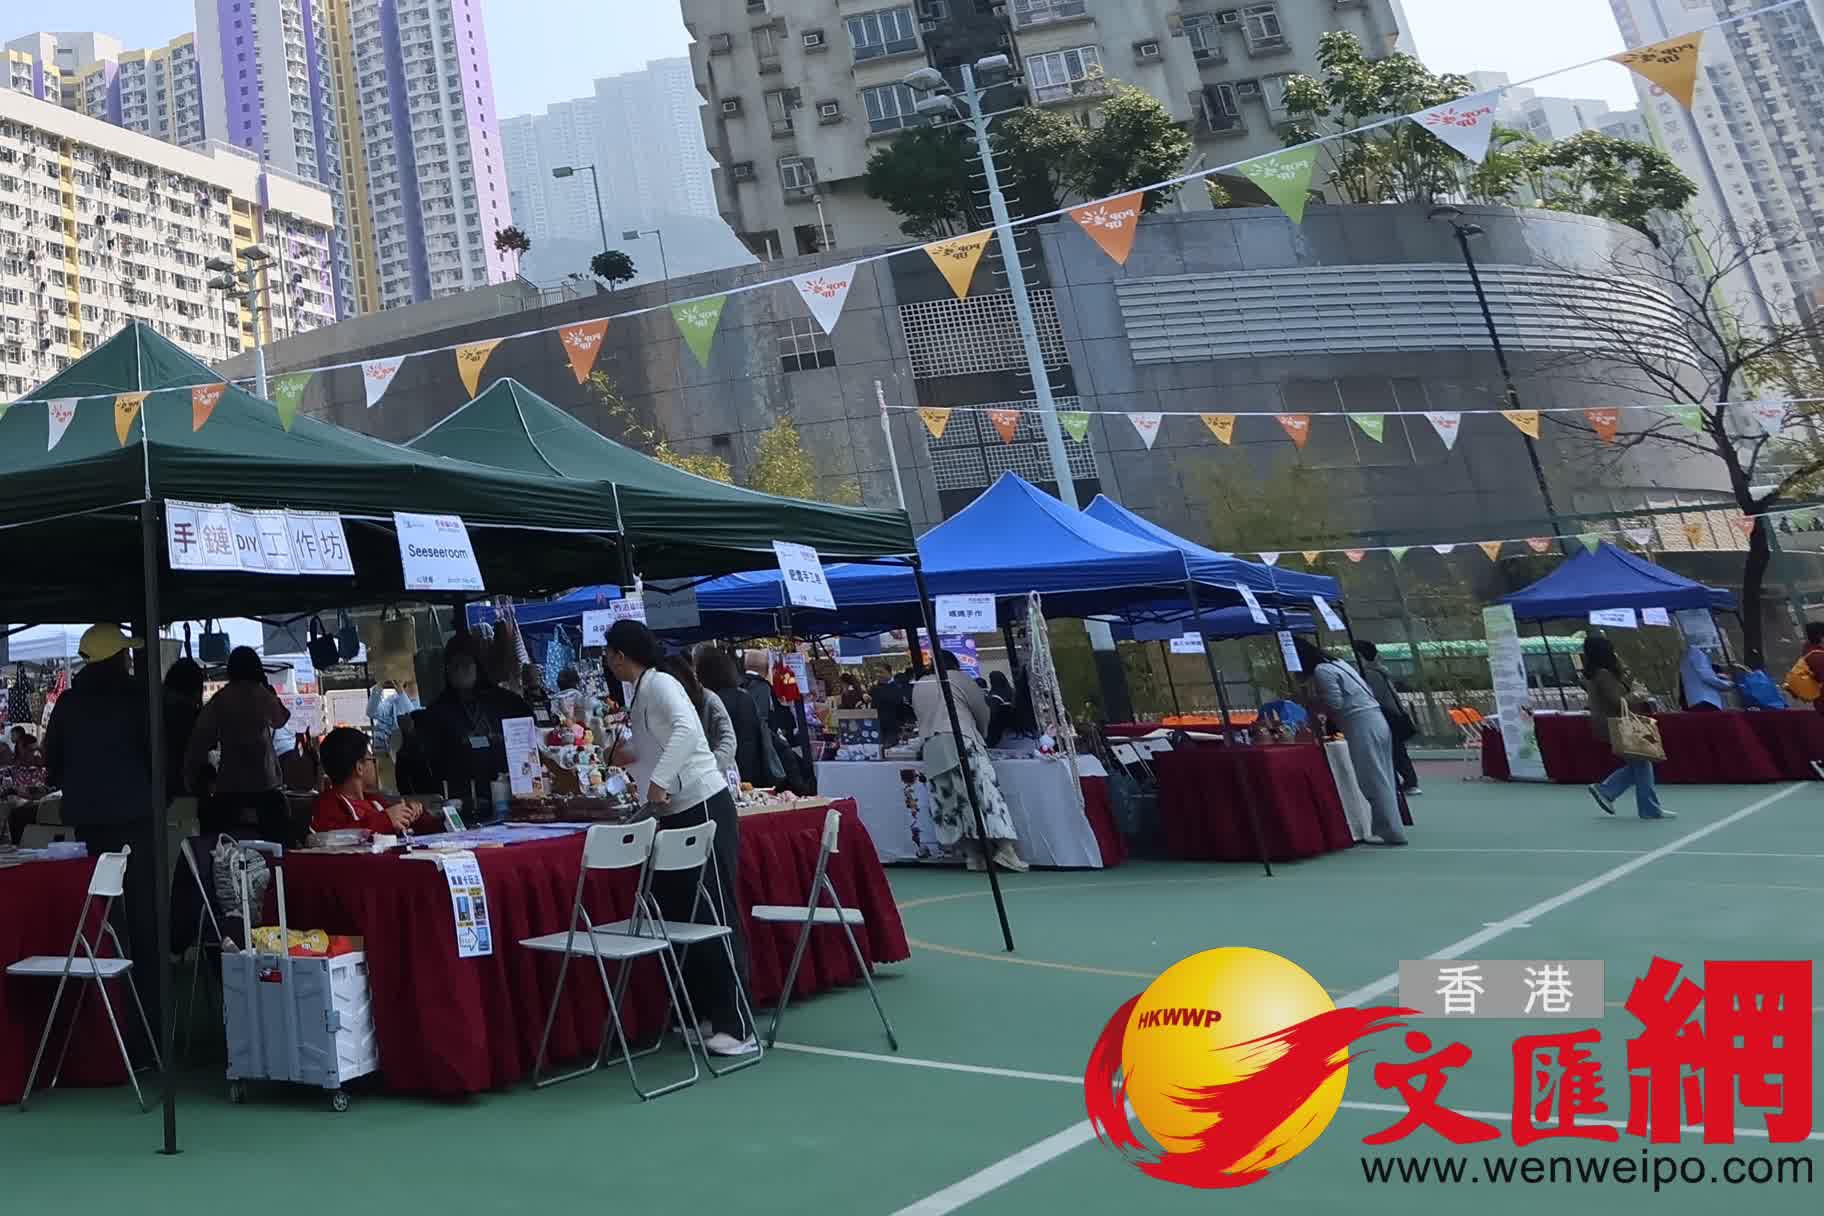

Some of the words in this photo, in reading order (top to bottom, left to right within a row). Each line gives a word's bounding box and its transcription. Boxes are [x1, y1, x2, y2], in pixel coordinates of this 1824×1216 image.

[173, 522, 344, 561] 手鏈DIY工作坊
[408, 543, 469, 559] Seeseeroom
